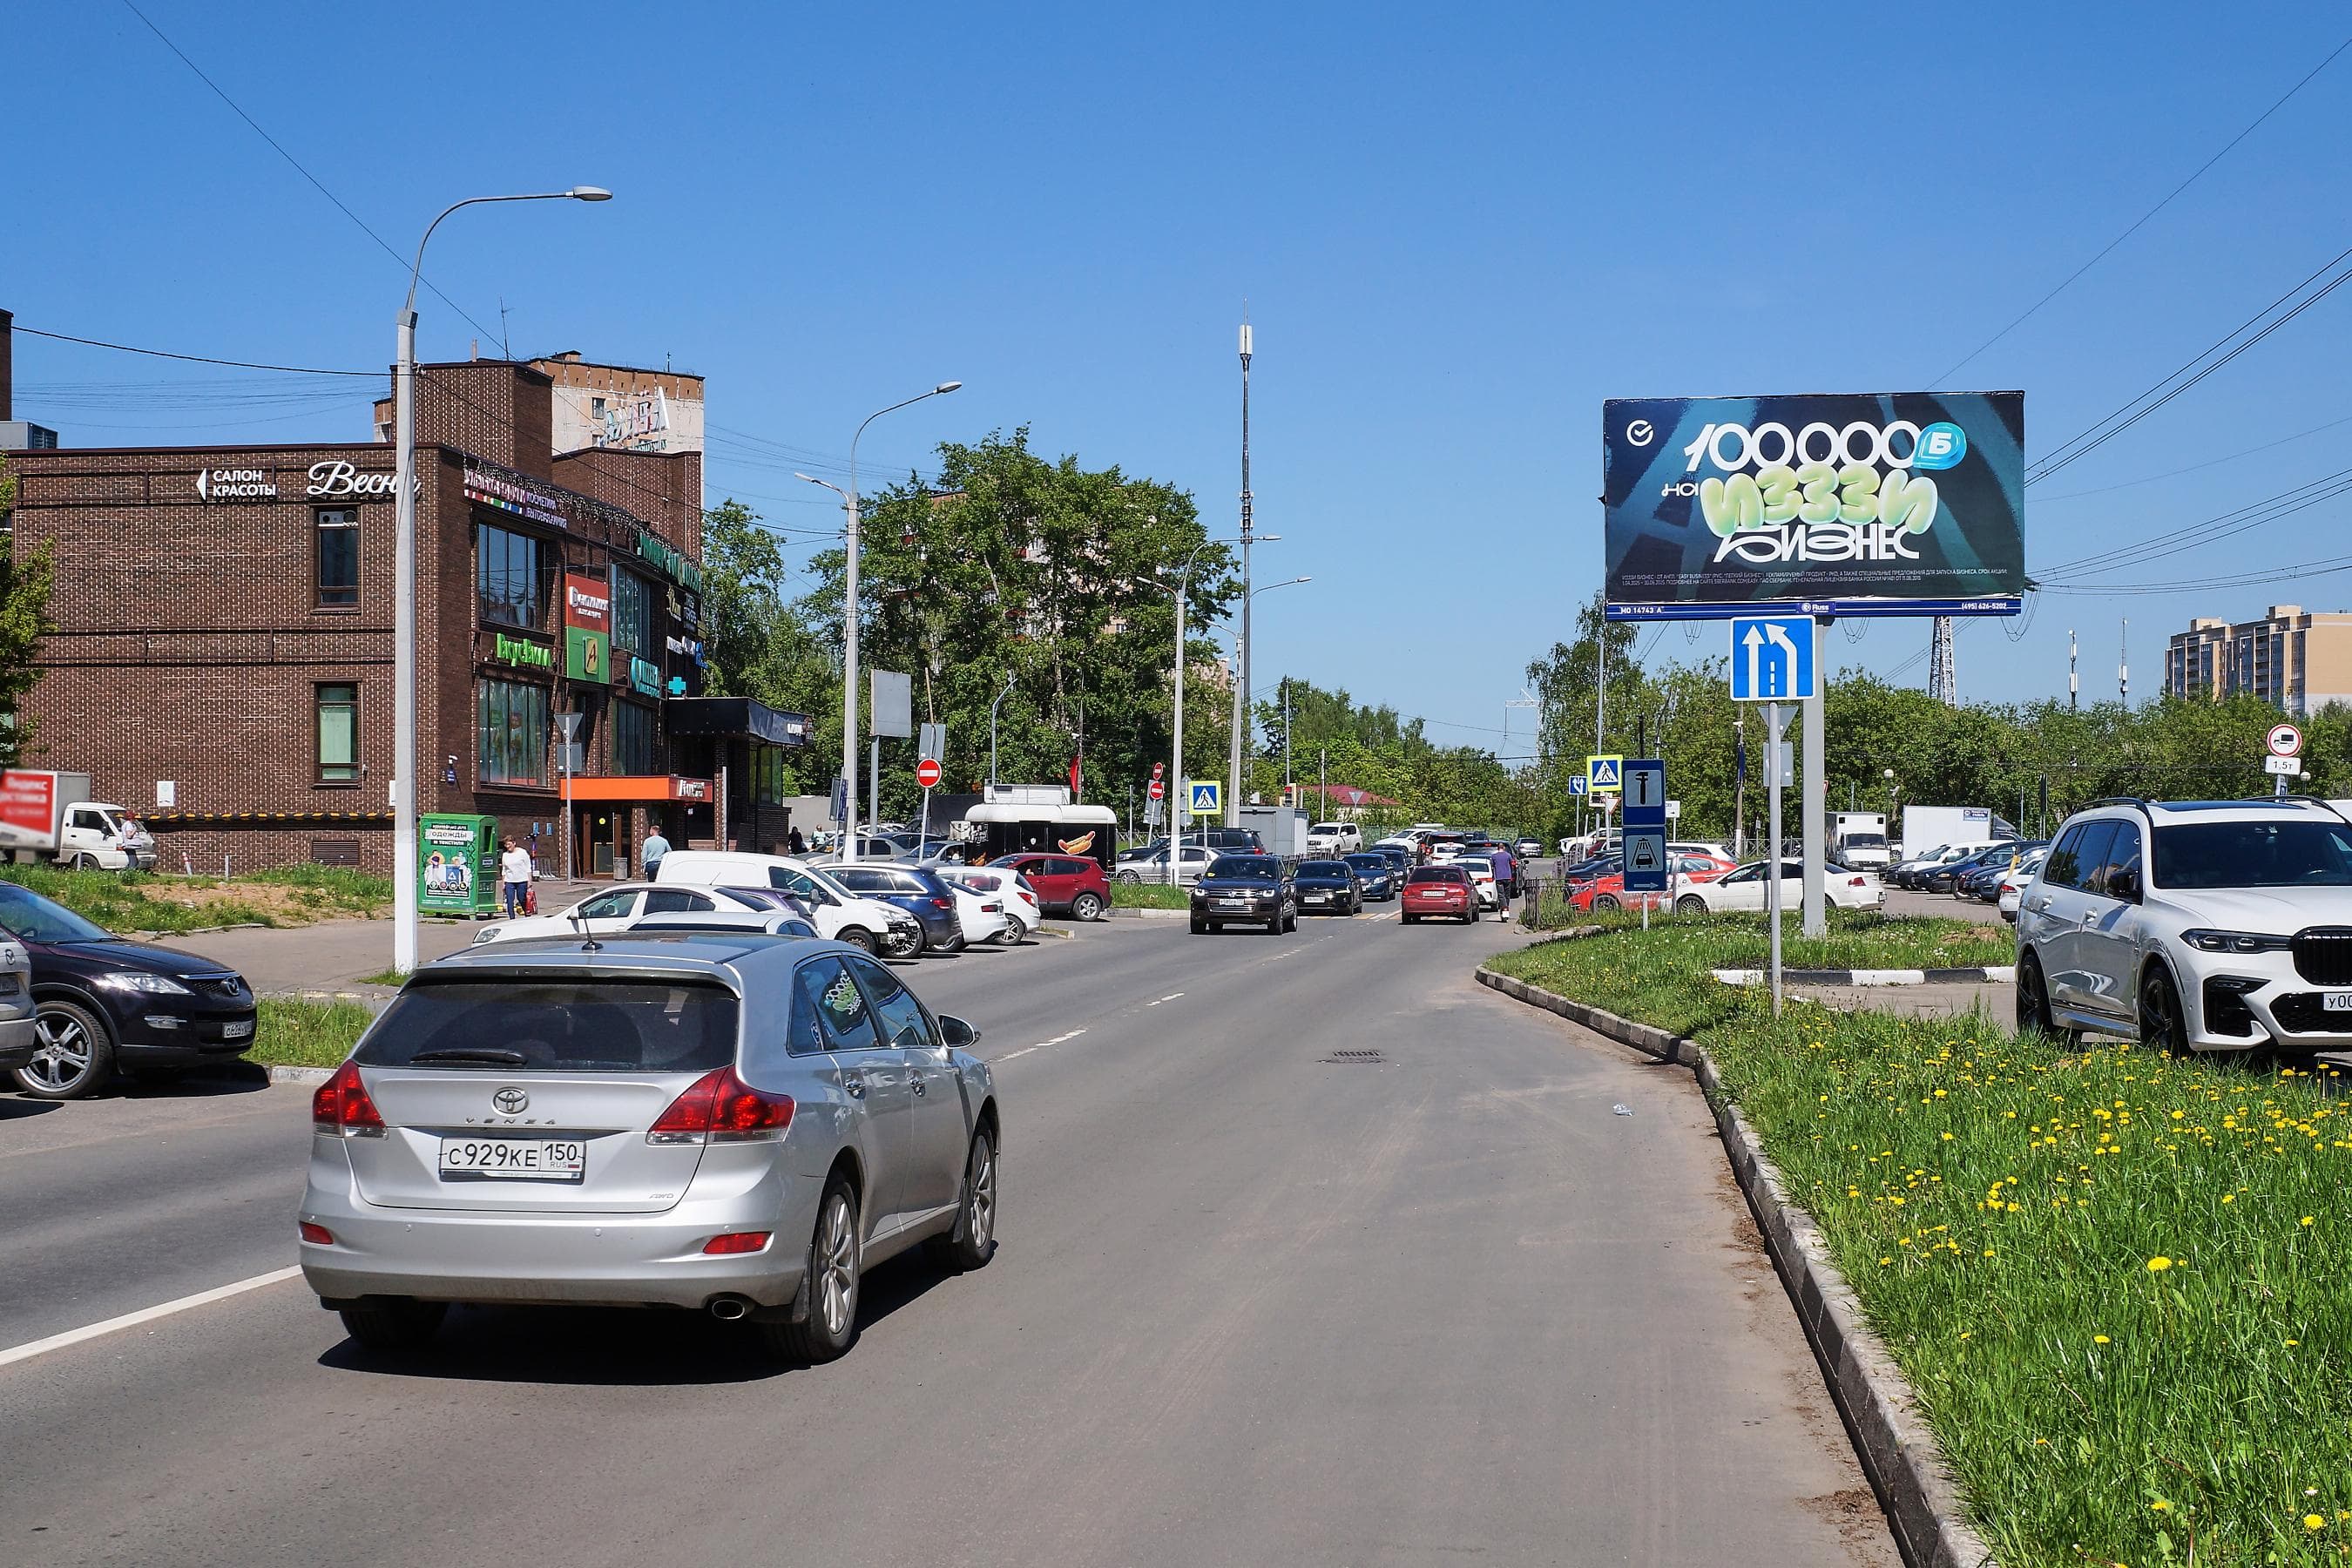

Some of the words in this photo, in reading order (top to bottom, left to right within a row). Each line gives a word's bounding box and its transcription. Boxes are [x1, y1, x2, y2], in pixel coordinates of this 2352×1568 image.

[213, 470, 263, 483] САЛОН
[213, 483, 276, 497] КРАСОТЫ
[1713, 522, 1921, 563] БИЗНЕС
[1961, 602, 1977, 611] (495)
[2273, 760, 2294, 770] 1,5т
[464, 1117, 558, 1125] VENZA
[449, 1143, 537, 1167] С929КЕ
[544, 1143, 578, 1161] 150
